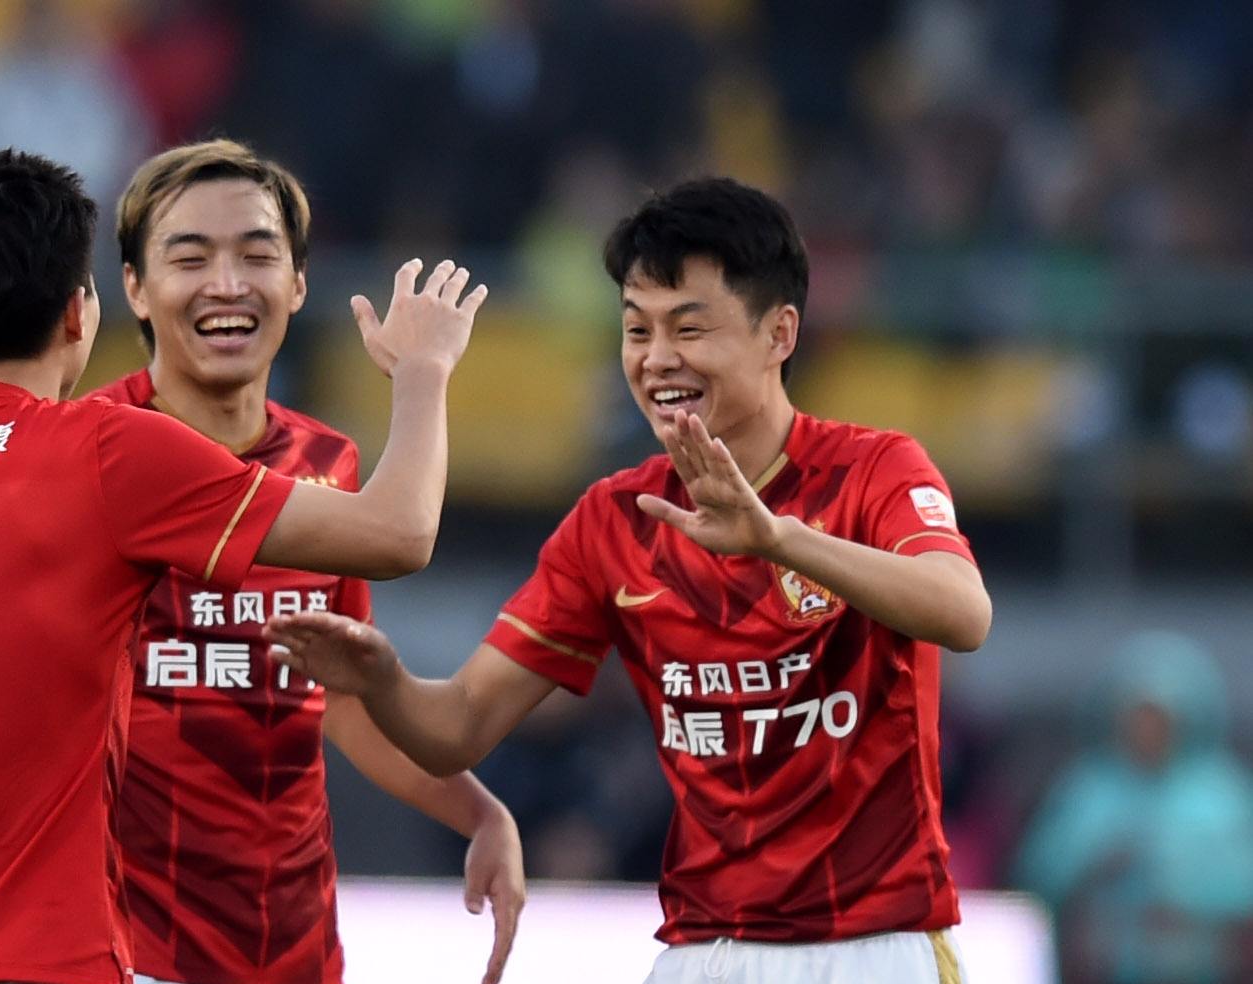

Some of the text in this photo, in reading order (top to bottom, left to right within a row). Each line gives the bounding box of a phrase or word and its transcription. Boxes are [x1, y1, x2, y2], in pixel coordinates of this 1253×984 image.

[146, 638, 253, 689] 启辰
[661, 652, 812, 697] 东风日产
[742, 690, 858, 755] T70
